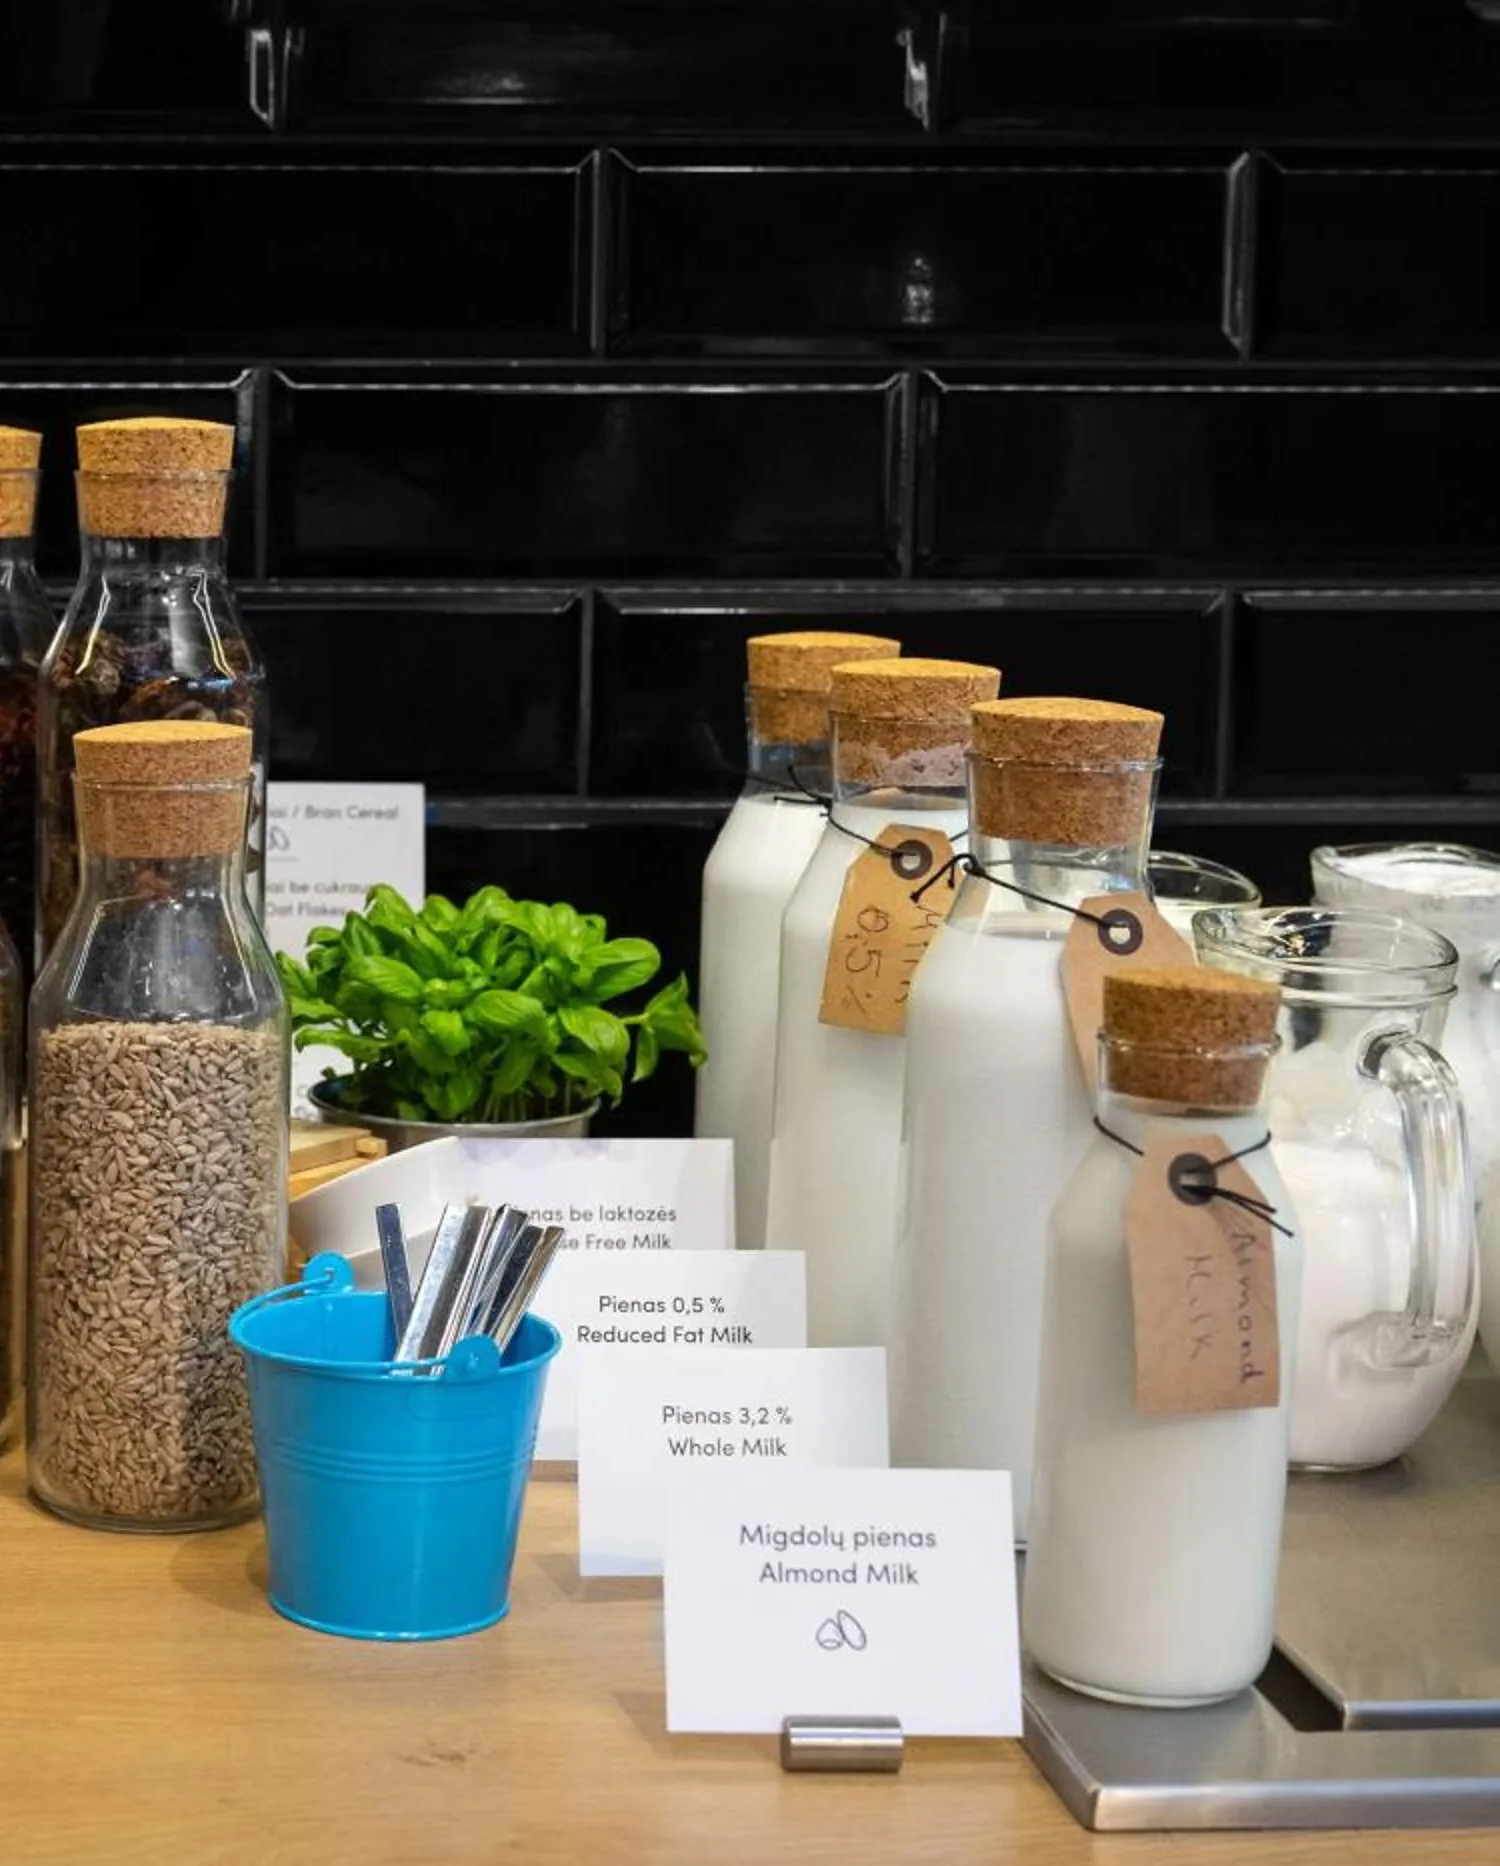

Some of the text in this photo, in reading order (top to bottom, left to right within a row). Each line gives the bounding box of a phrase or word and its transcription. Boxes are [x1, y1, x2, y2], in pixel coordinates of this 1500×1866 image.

[304, 804, 343, 820] Bran
[347, 804, 399, 821] Cereal
[569, 1203, 593, 1223] be
[599, 1203, 678, 1223] laktozės
[585, 1233, 627, 1250] Free
[632, 1232, 673, 1250] Milk
[598, 1295, 726, 1316] Pienas 0,5 %
[576, 1325, 754, 1345] Reduced Fat Milk
[661, 1405, 792, 1428] Pienas 3,2 %
[667, 1437, 788, 1458] Whole Milk
[738, 1524, 937, 1552] Migdolų pienas
[758, 1562, 920, 1586] Almond Milk
